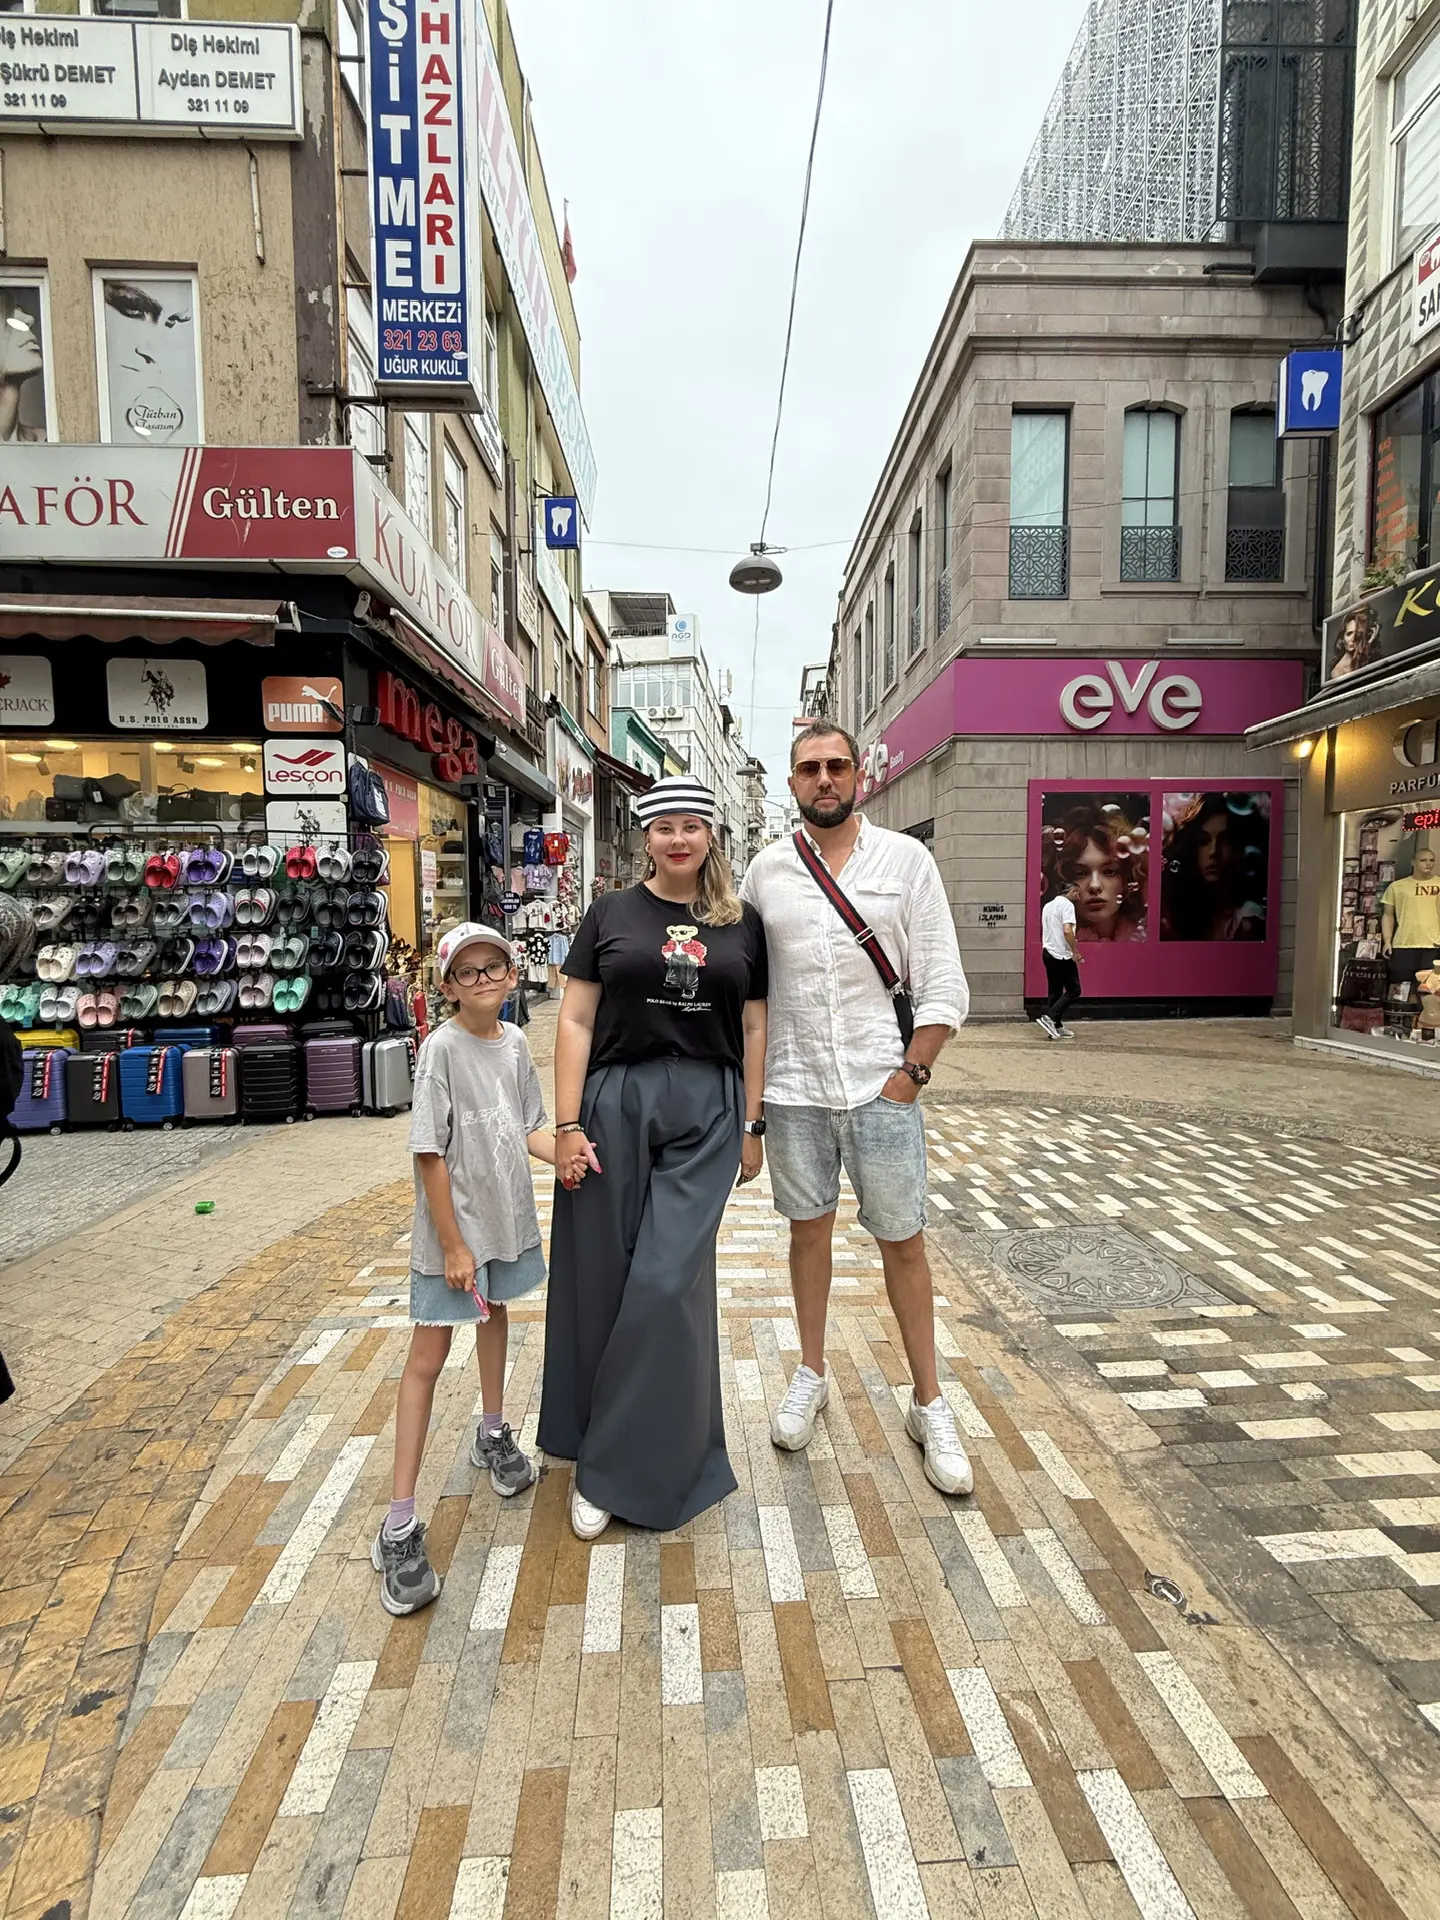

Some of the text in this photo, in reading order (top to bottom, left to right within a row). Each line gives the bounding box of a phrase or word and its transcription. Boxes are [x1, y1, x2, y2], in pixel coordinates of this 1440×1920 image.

[20, 26, 79, 47] Hekimi
[170, 33, 260, 56] Diş Hekimi
[0, 62, 116, 85] Şükrü DEMET
[158, 69, 276, 90] Aydan DEMET
[4, 92, 67, 108] 321 11 09
[187, 99, 249, 114] 321 11 09
[384, 329, 462, 352] 321 23 63
[384, 354, 462, 376] UĞUR KUKUL
[203, 486, 341, 520] Gülten
[369, 487, 523, 708] KUAFÖR Gülten
[144, 716, 169, 724] POLO
[267, 703, 324, 723] PUMA
